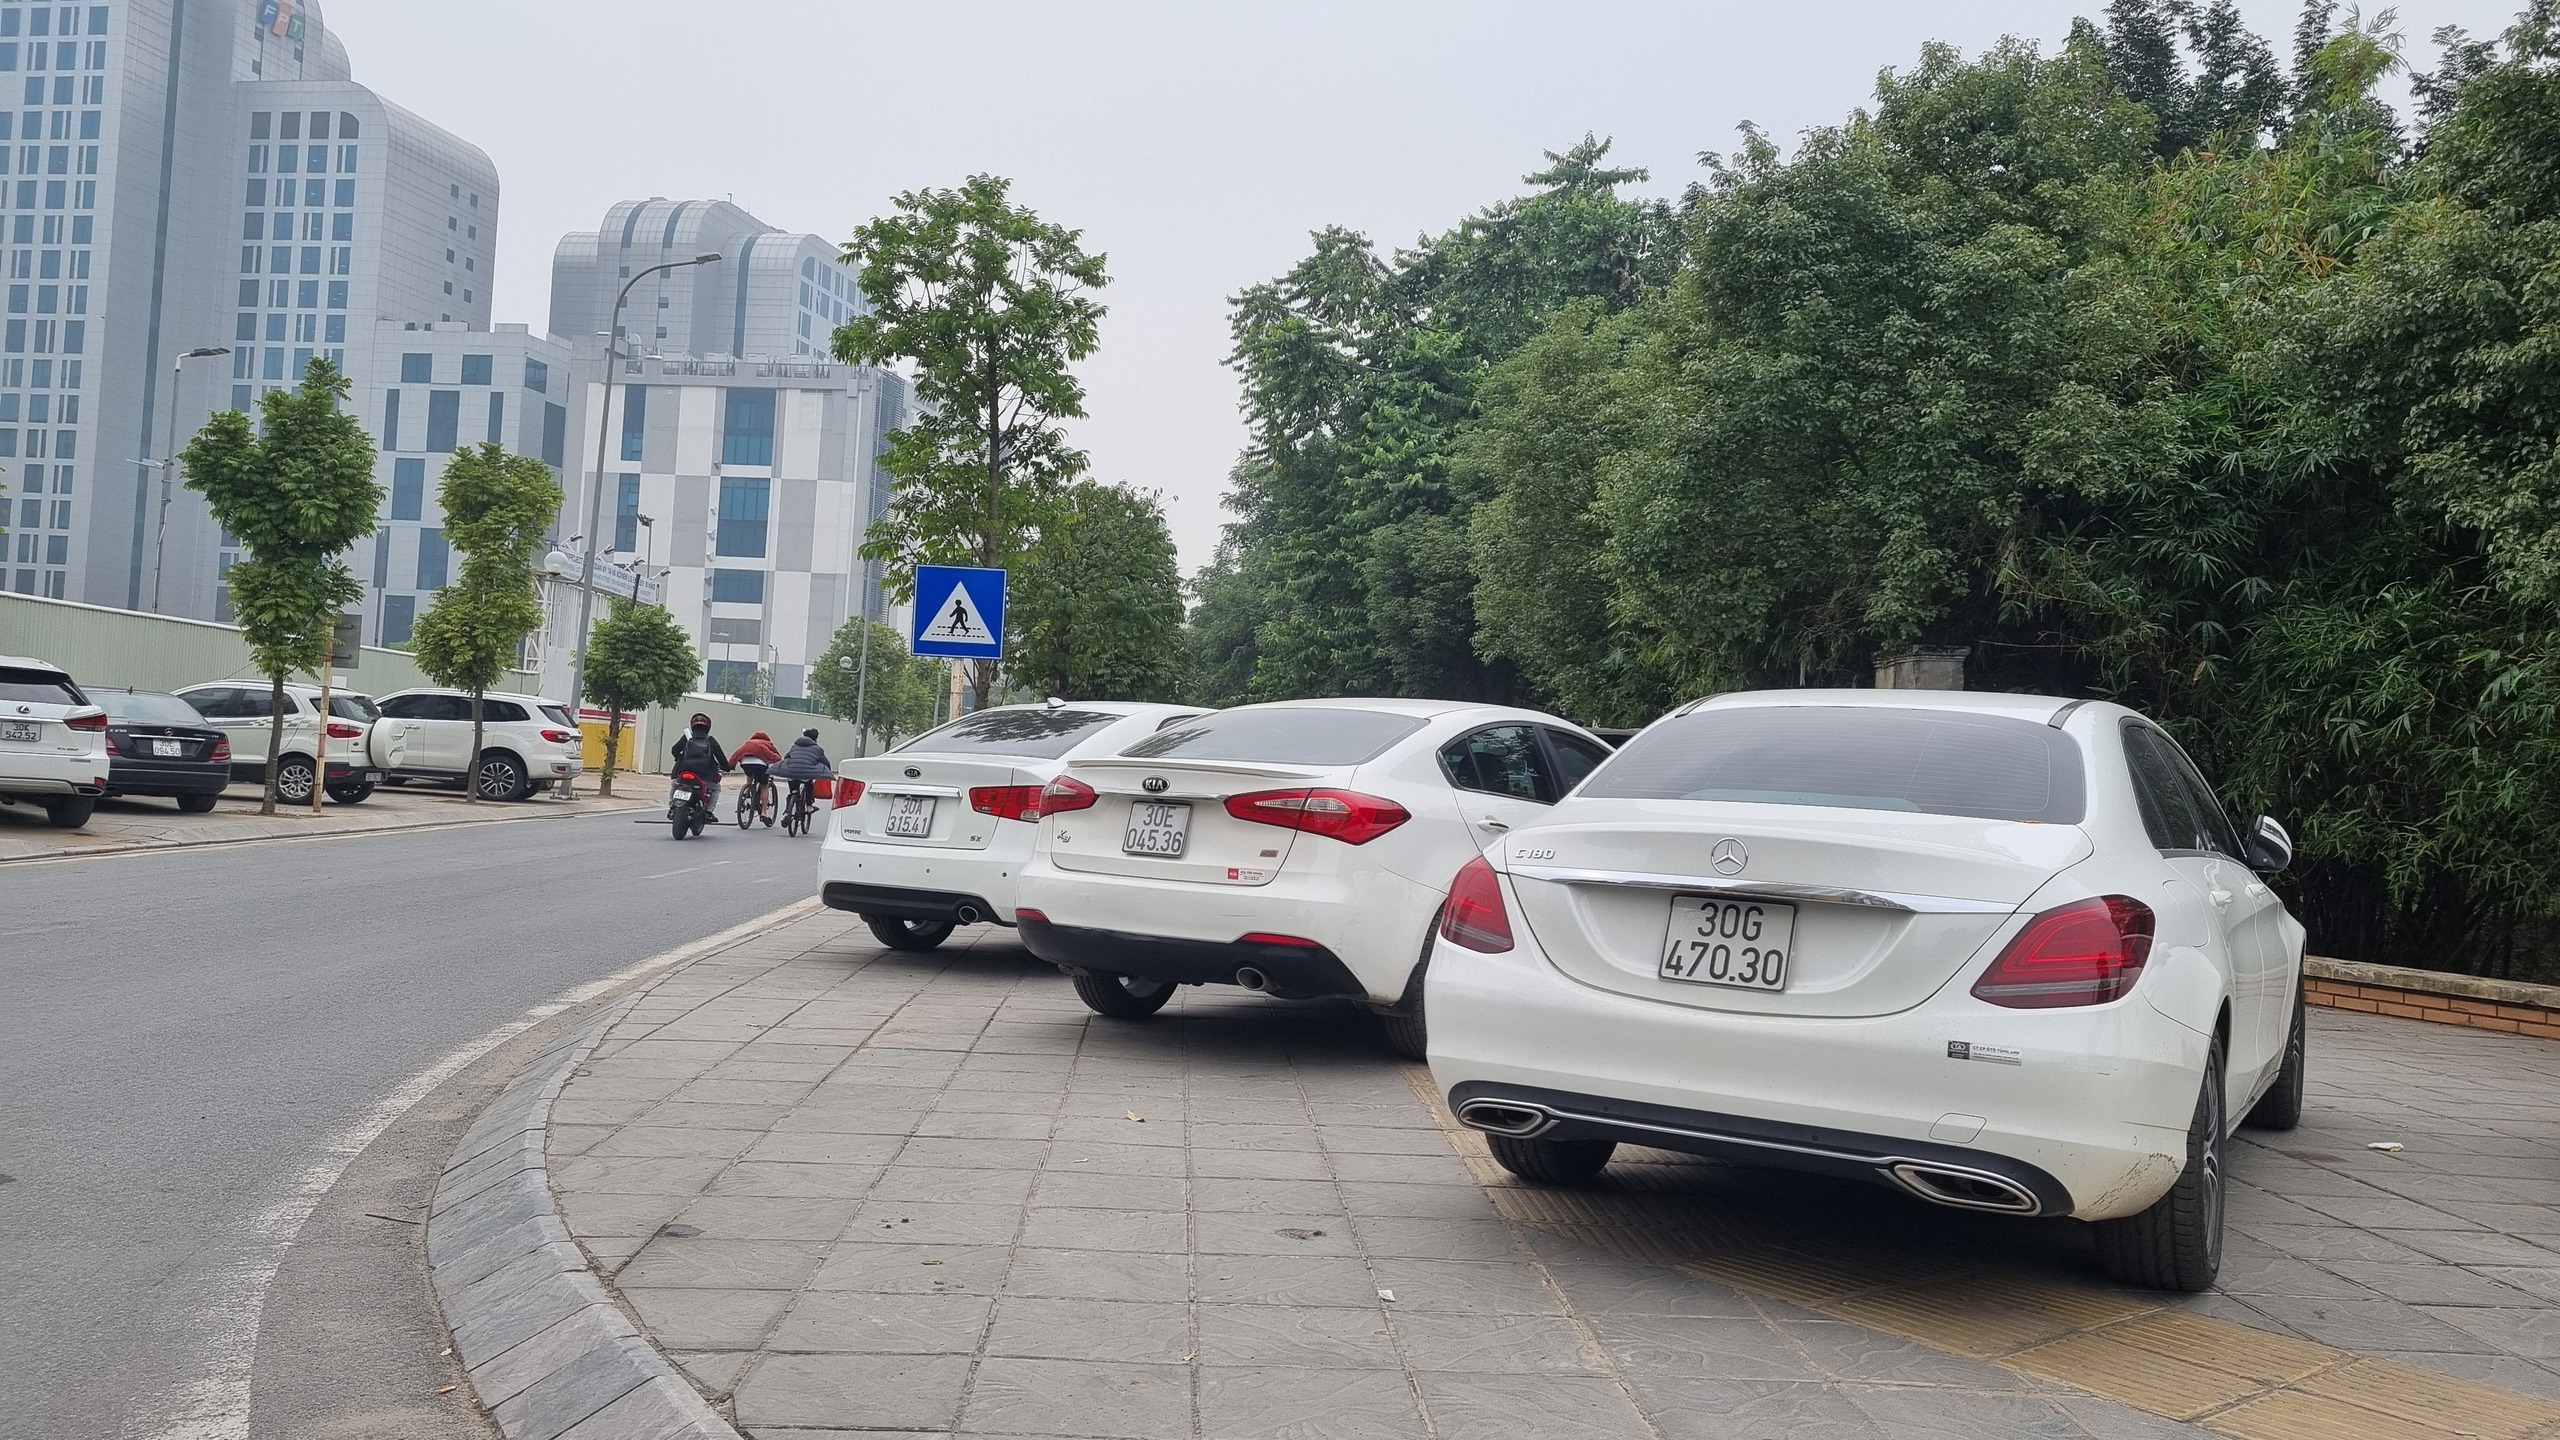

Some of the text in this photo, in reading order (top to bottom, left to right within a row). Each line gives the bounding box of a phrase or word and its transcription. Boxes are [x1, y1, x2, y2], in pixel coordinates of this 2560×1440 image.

[263, 3, 303, 33] FPT
[5, 731, 37, 741] 542.52
[13, 723, 30, 732] 30K
[1144, 779, 1165, 791] KIA
[900, 797, 923, 815] 30A
[887, 815, 928, 834] 315.41
[1142, 804, 1177, 829] 30E
[969, 835, 982, 843] SX
[1125, 827, 1184, 854] 045.36
[1697, 901, 1765, 942] 30G
[1664, 938, 1785, 987] 470.30
